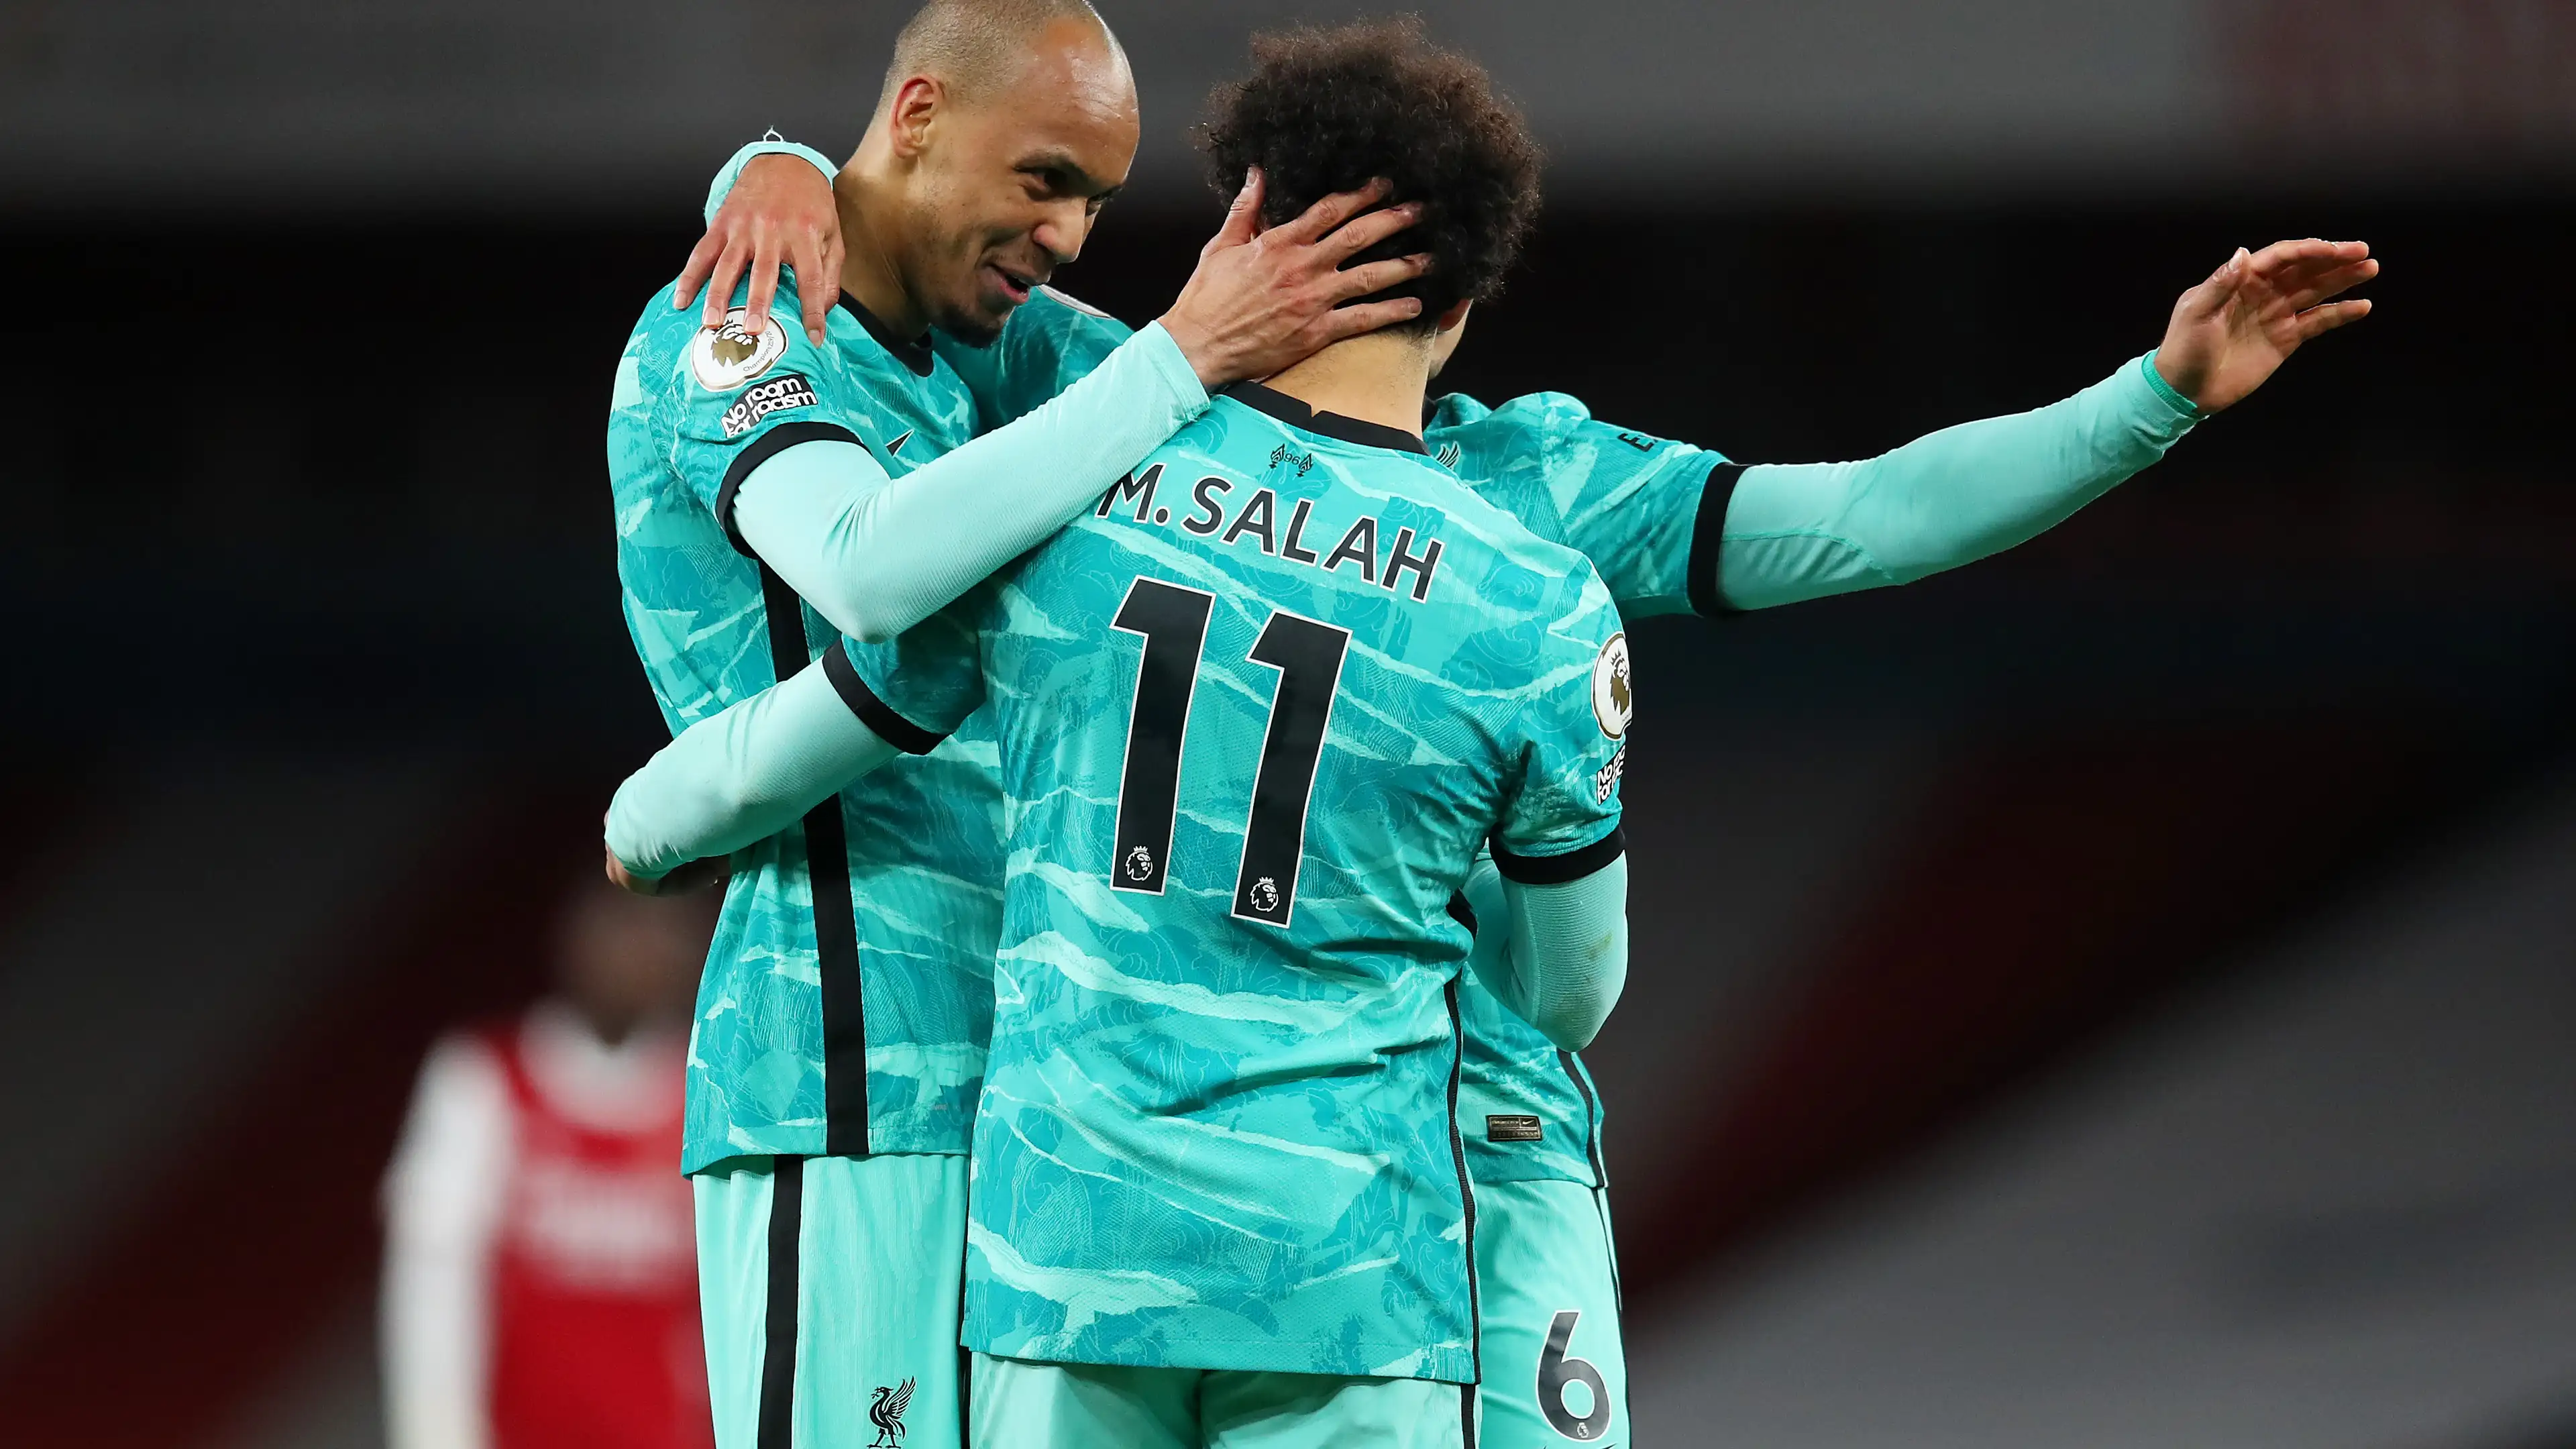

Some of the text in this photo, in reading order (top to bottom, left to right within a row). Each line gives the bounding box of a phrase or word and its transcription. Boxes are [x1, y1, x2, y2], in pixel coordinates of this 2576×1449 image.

[720, 378, 802, 431] No room
[751, 391, 818, 422] racism
[1284, 453, 1301, 465] 96
[1109, 574, 1353, 929] 11
[1597, 764, 1613, 785] No
[1535, 1309, 1611, 1442] 6
